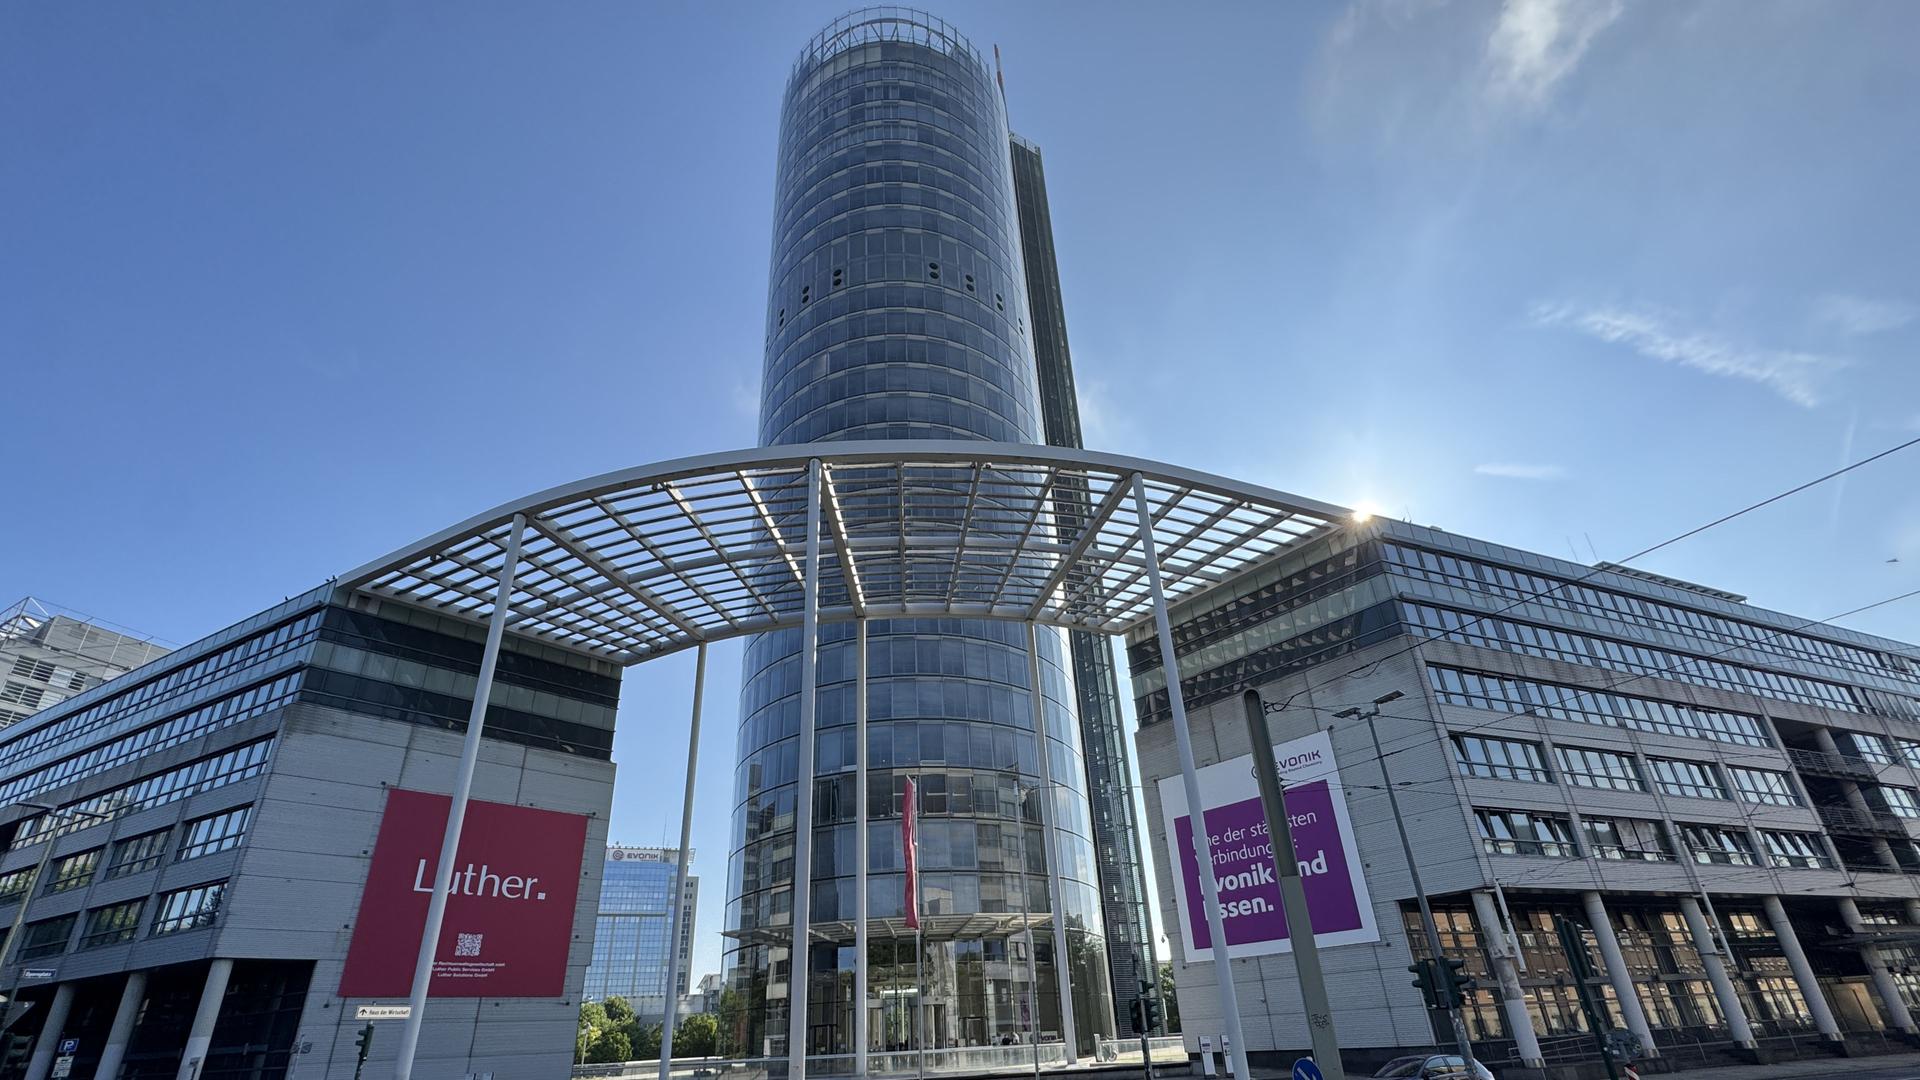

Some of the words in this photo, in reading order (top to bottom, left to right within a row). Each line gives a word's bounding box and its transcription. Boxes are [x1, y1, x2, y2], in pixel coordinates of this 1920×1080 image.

[1192, 834, 1221, 850] ne
[1223, 827, 1246, 843] der
[1250, 811, 1317, 838] stästen
[1199, 862, 1275, 895] vonik
[1297, 849, 1328, 877] nd
[1203, 896, 1274, 920] ssen.
[64, 1041, 74, 1051] P
